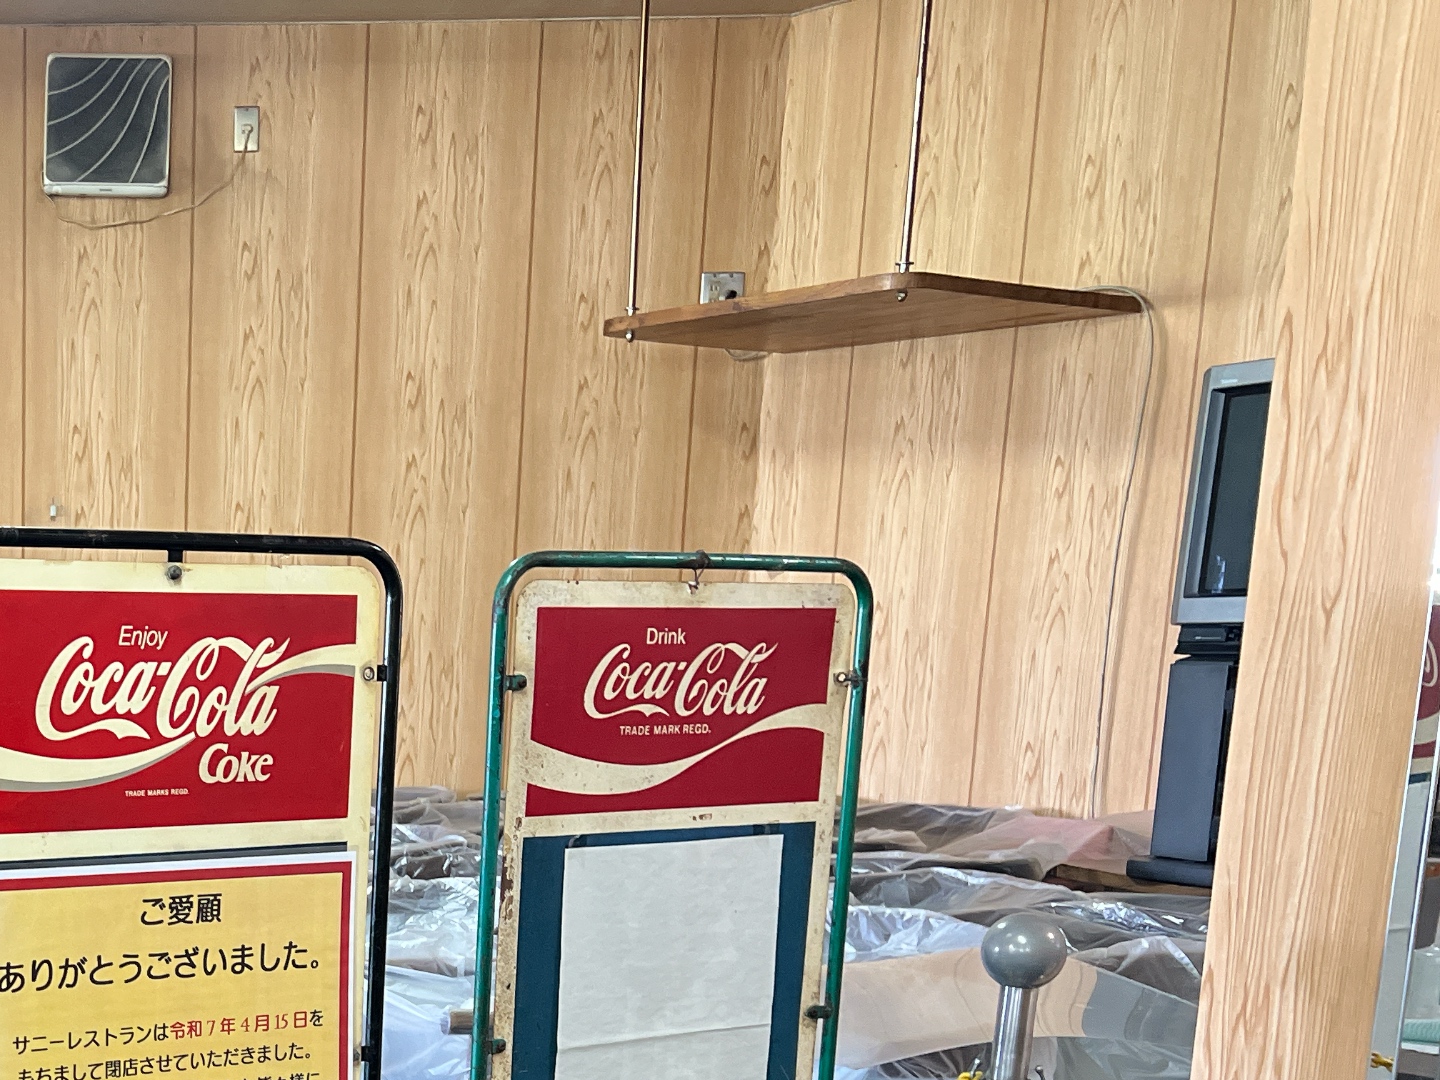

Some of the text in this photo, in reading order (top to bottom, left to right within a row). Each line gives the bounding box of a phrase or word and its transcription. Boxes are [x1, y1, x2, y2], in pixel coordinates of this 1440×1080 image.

[119, 625, 168, 650] Enjoy
[646, 628, 686, 645] Drink
[35, 636, 290, 741] Coca-Cola
[584, 642, 778, 719] Coca-Cola
[620, 723, 711, 736] TRADE MARK REGD.
[199, 744, 274, 784] Coke
[140, 893, 223, 926] ご愛顧
